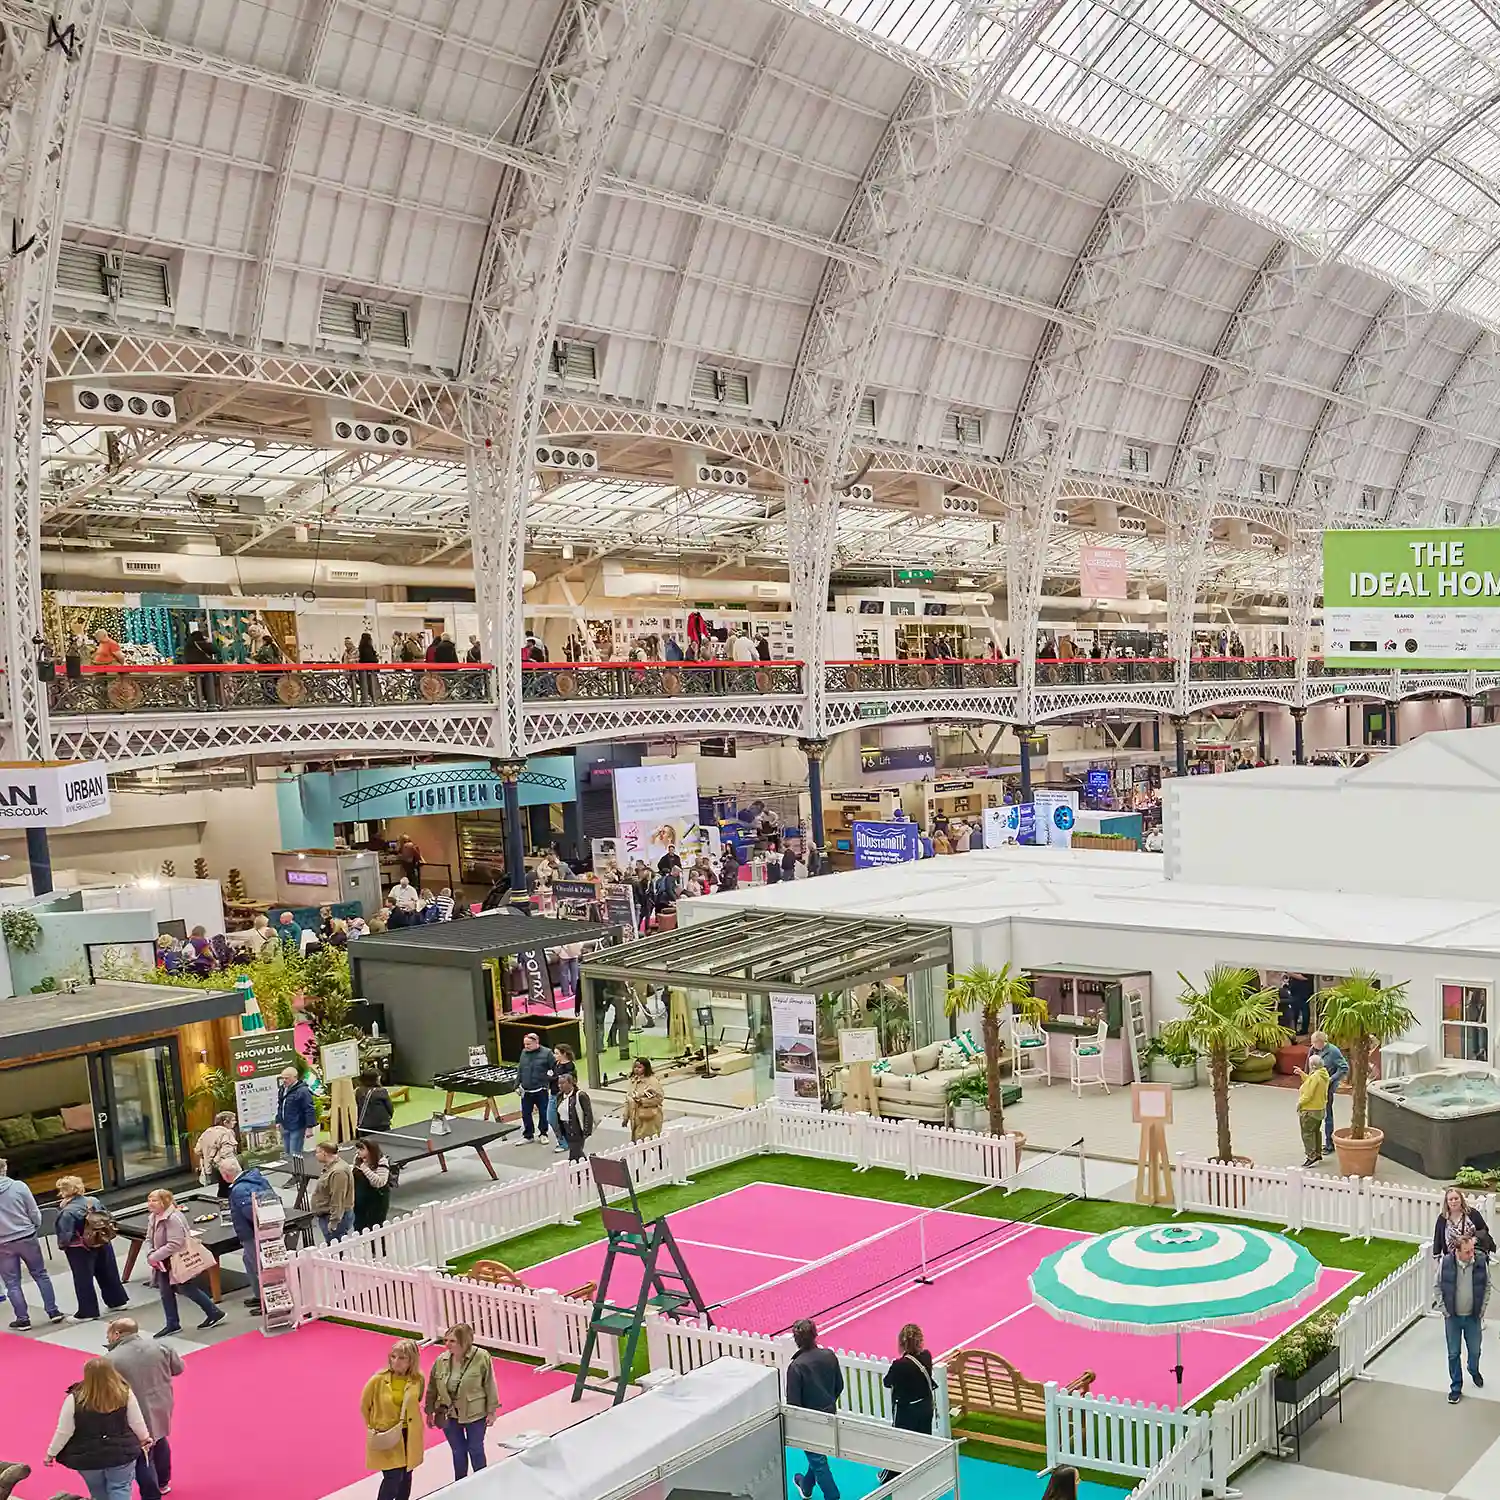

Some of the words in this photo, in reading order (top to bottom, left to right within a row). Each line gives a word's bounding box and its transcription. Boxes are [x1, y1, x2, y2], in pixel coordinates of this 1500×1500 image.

[1410, 542, 1464, 567] THE
[1350, 572, 1430, 597] IDEAL
[879, 757, 891, 765] Lift
[65, 776, 103, 802] URBAN
[407, 783, 488, 810] EIGHTEEN
[235, 1047, 266, 1060] SHOW
[267, 1044, 293, 1054] DEAL
